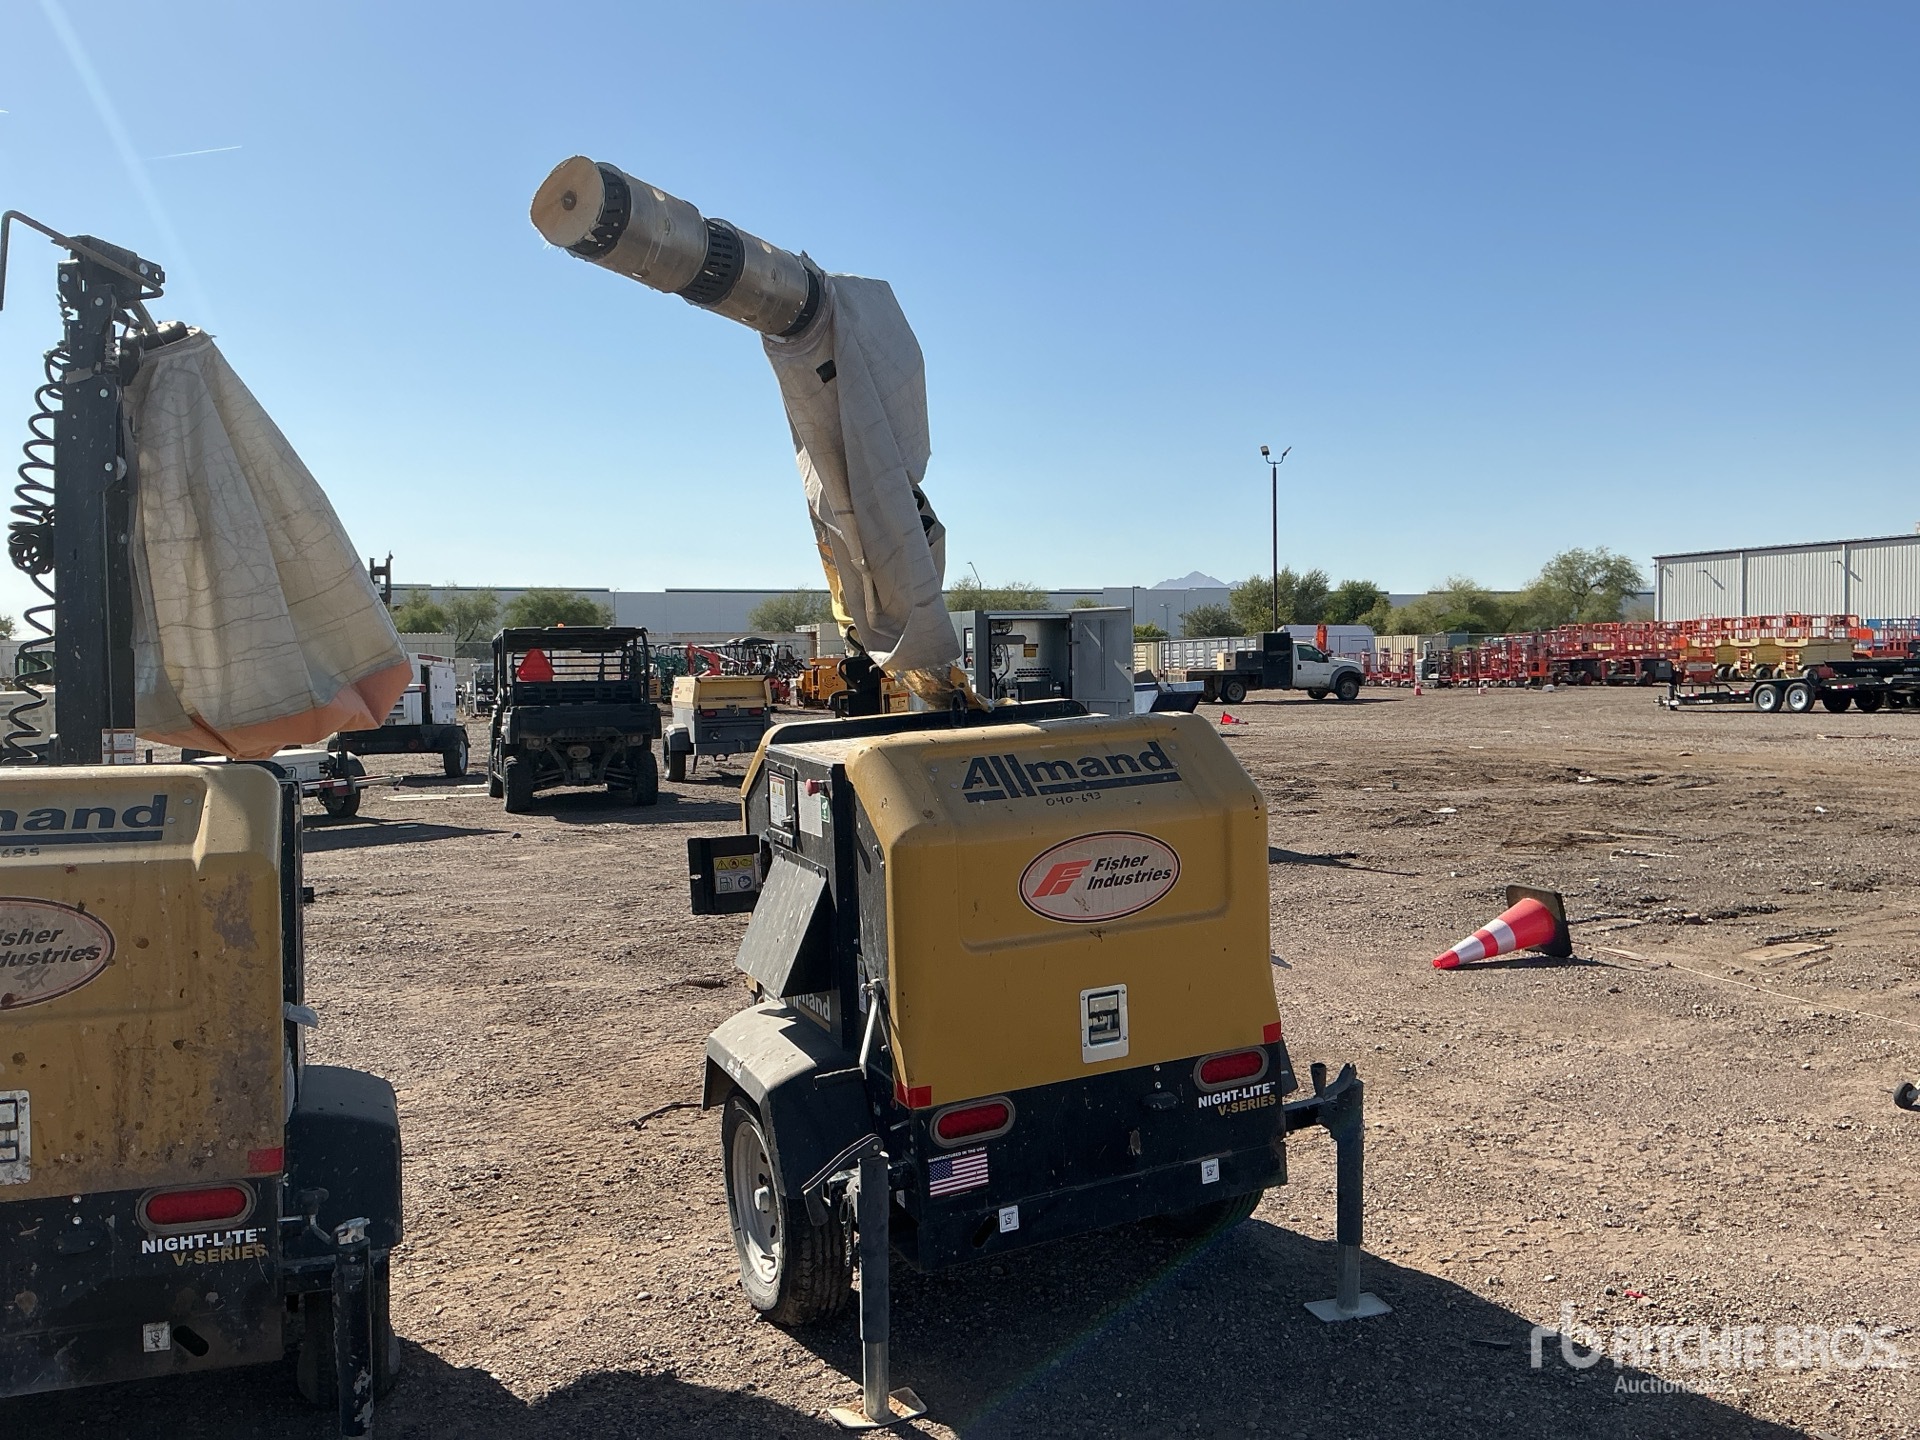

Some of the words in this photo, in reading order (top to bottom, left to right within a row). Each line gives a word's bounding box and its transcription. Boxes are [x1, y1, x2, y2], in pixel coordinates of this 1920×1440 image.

[962, 741, 1173, 799] Allmand
[1046, 791, 1101, 806] 040-693
[0, 794, 168, 832] and
[1093, 854, 1149, 872] Fisher
[1086, 867, 1173, 890] Industries
[1217, 1094, 1277, 1116] V-SERIES
[927, 1151, 962, 1163] MANUFACTURED
[172, 1243, 269, 1266] V-SERIES
